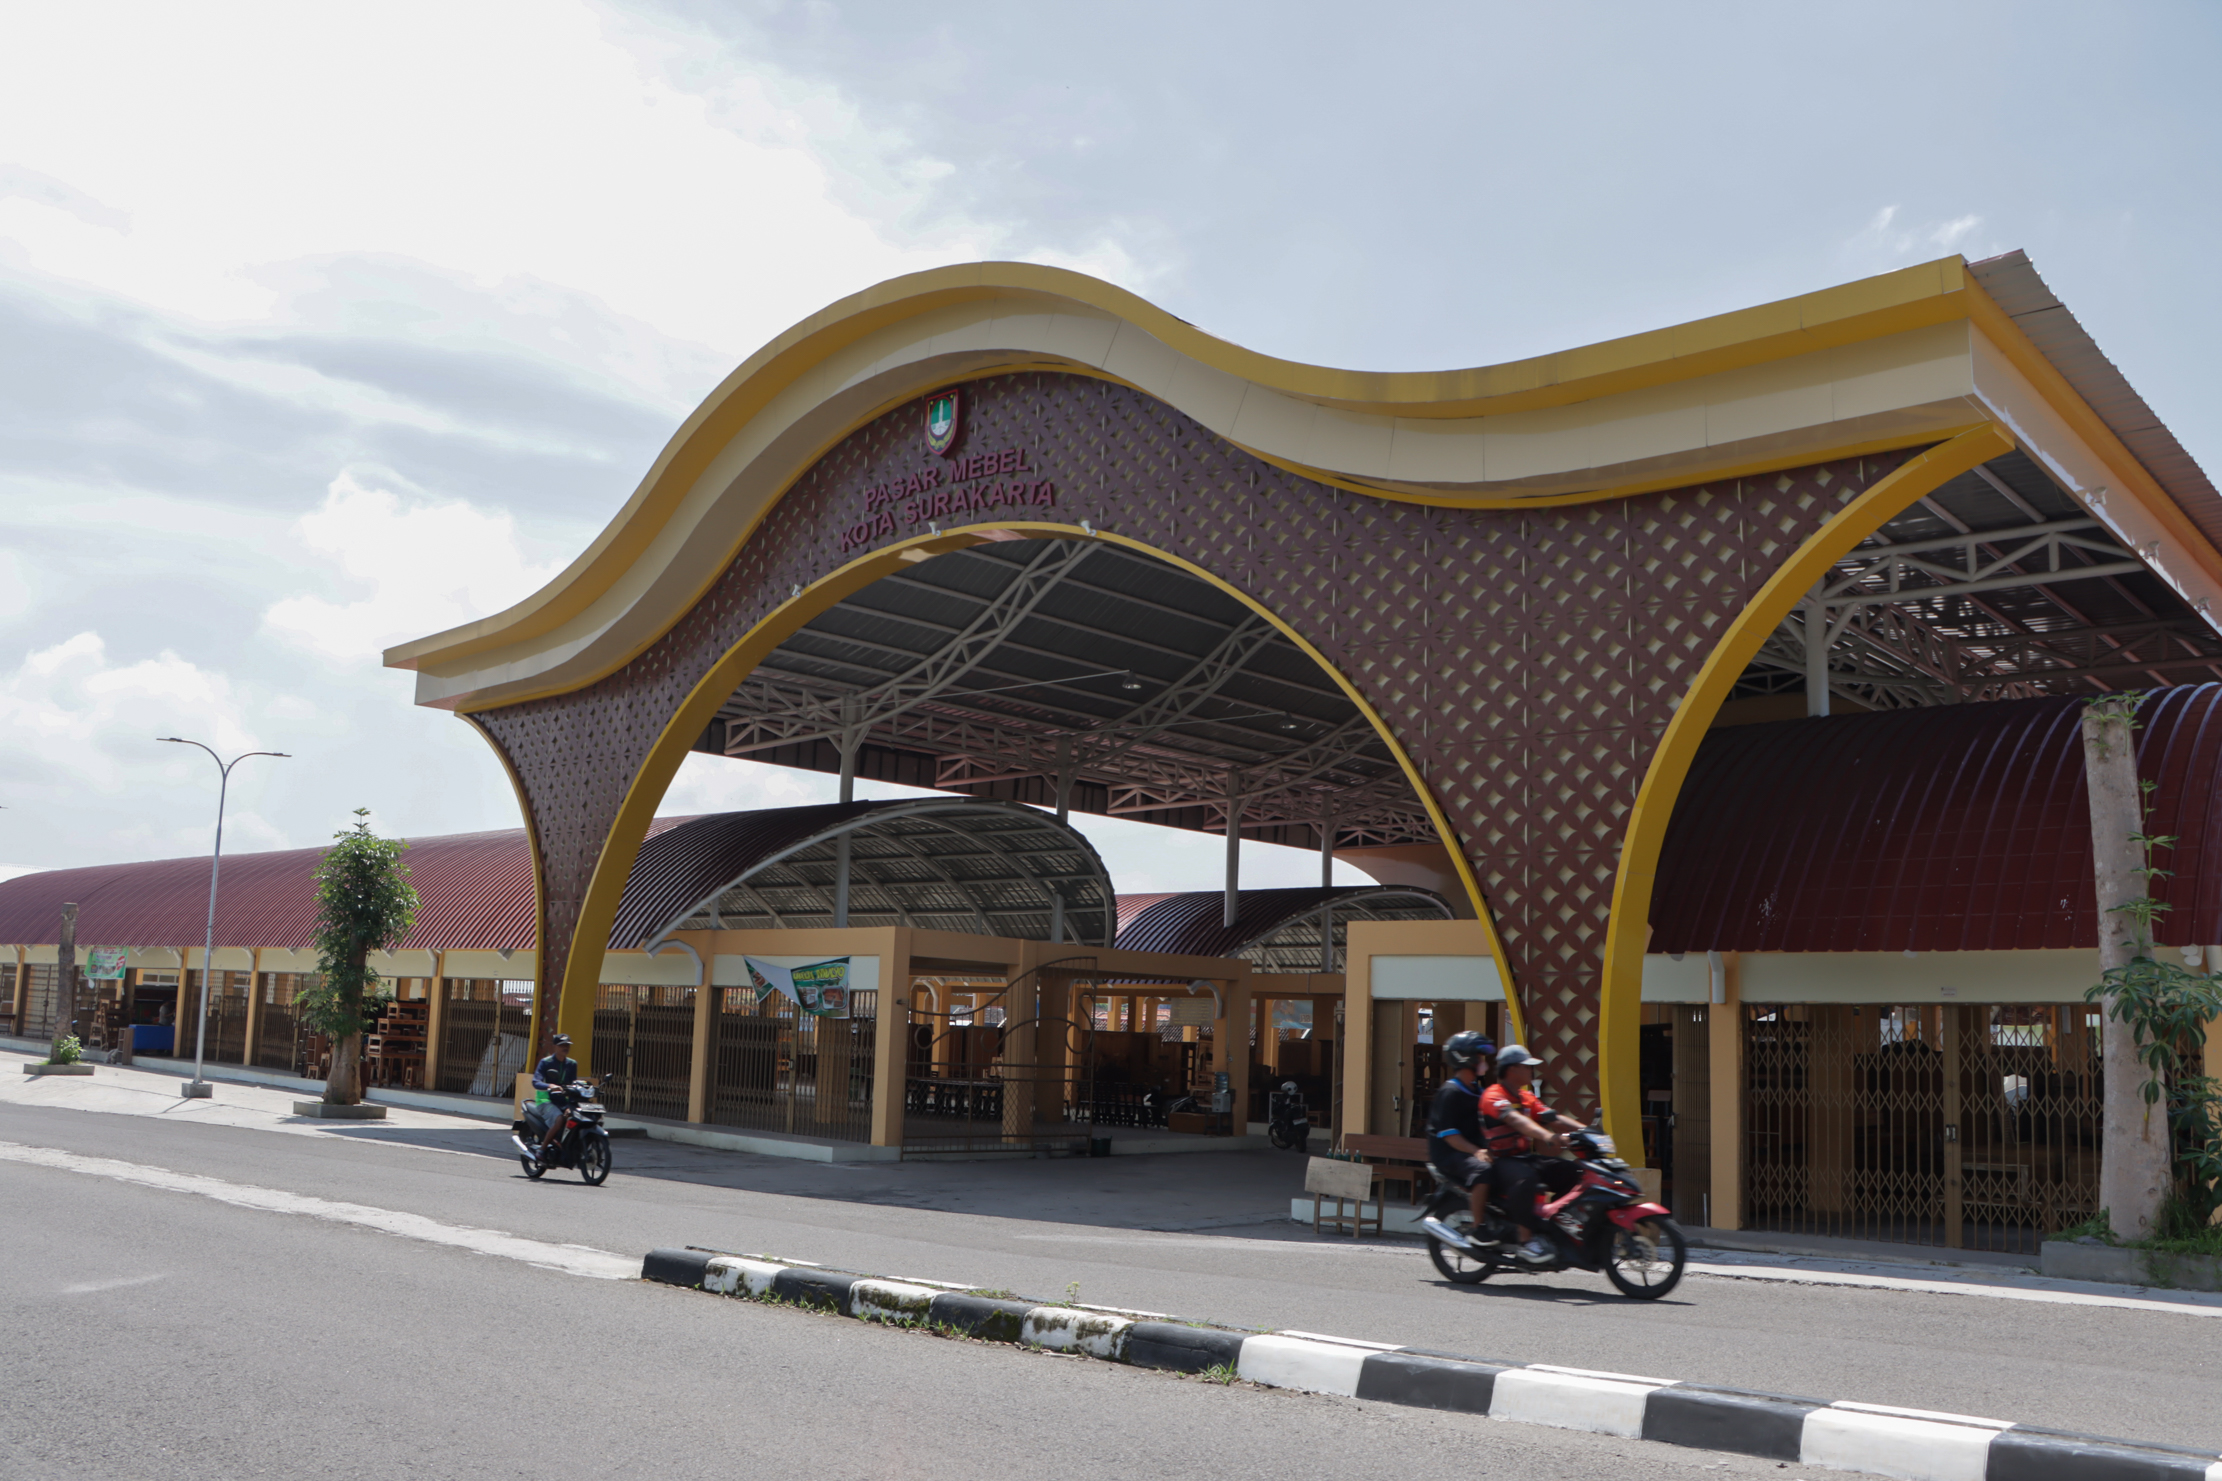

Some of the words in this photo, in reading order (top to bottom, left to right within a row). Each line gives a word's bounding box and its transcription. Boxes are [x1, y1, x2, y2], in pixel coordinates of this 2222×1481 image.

[864, 466, 939, 511] PASAR
[949, 448, 1029, 483] MEBEL
[840, 510, 895, 552] KOTA
[904, 481, 1055, 524] SURAKARTA
